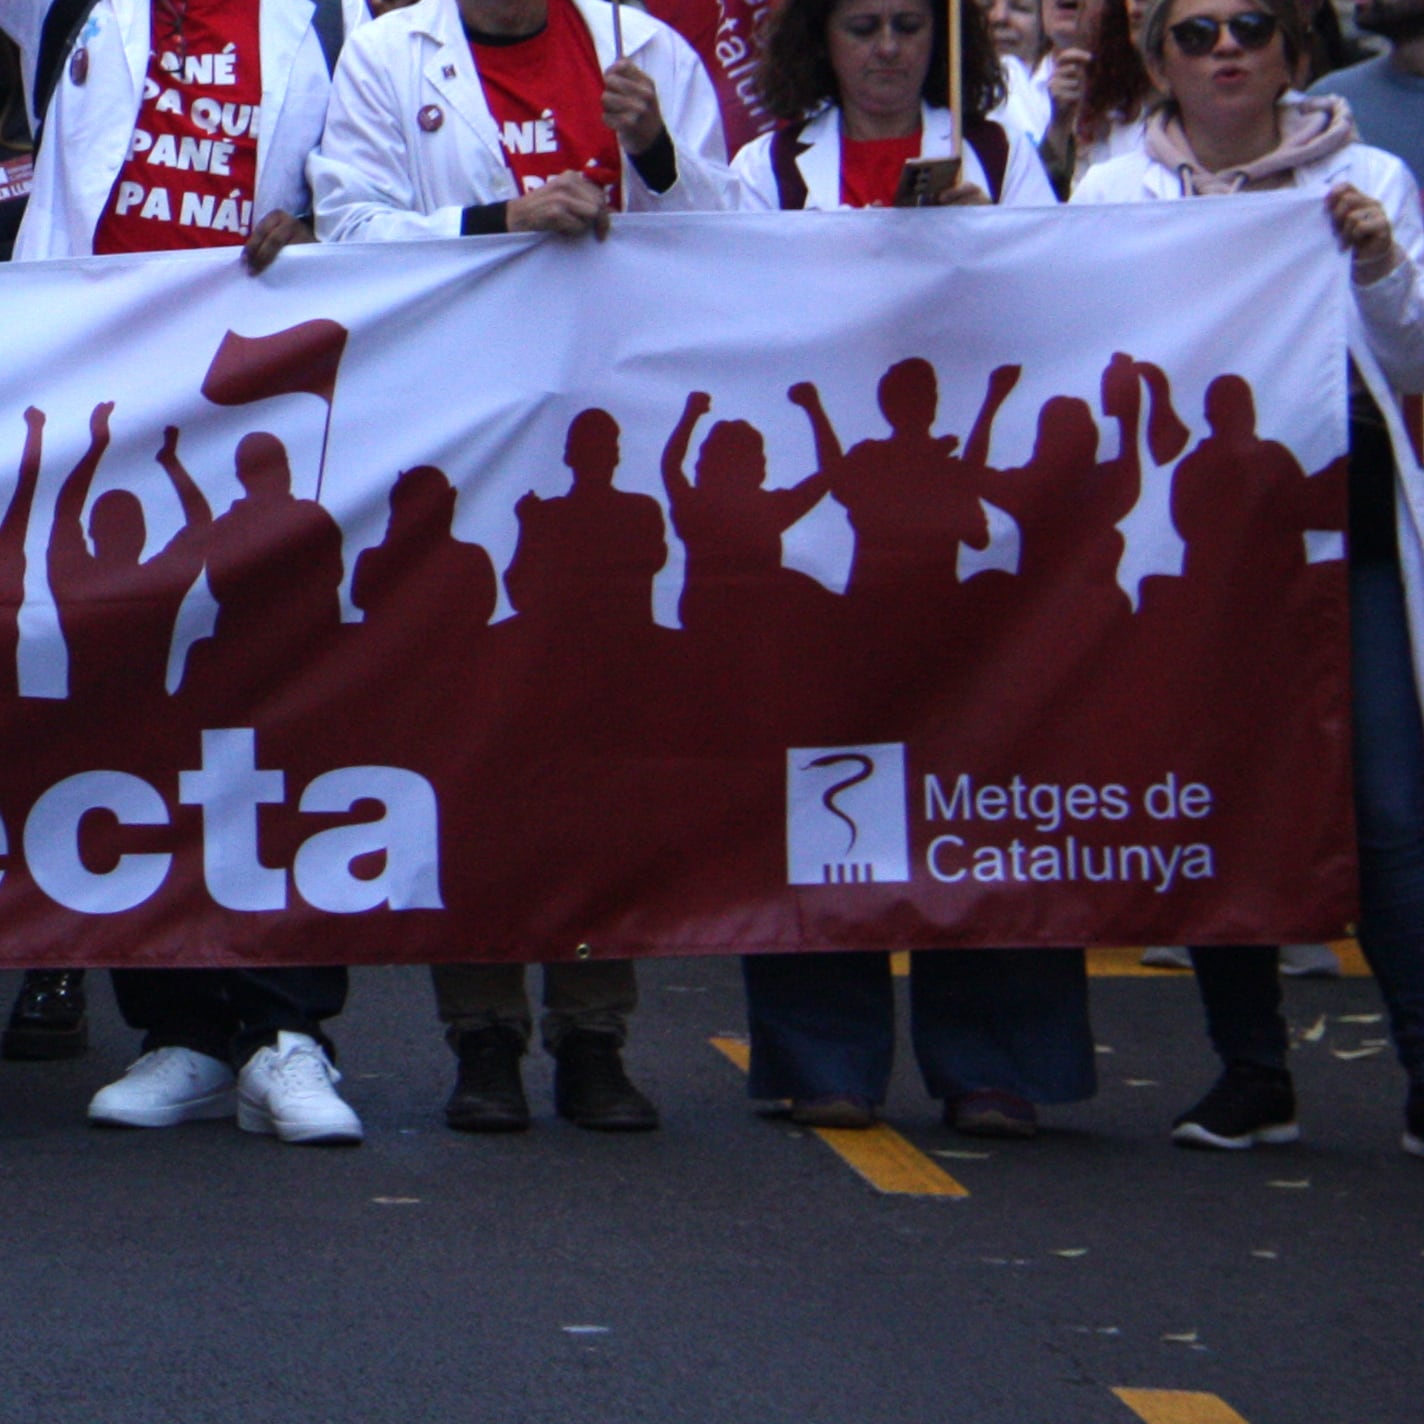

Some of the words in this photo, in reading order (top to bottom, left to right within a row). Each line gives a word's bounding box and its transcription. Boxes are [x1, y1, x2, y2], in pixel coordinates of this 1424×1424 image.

[114, 180, 172, 222] PA
[178, 187, 254, 237] NÁ!
[923, 772, 1129, 832] Metges
[1143, 771, 1213, 821] de
[925, 833, 1216, 894] Catalunya
